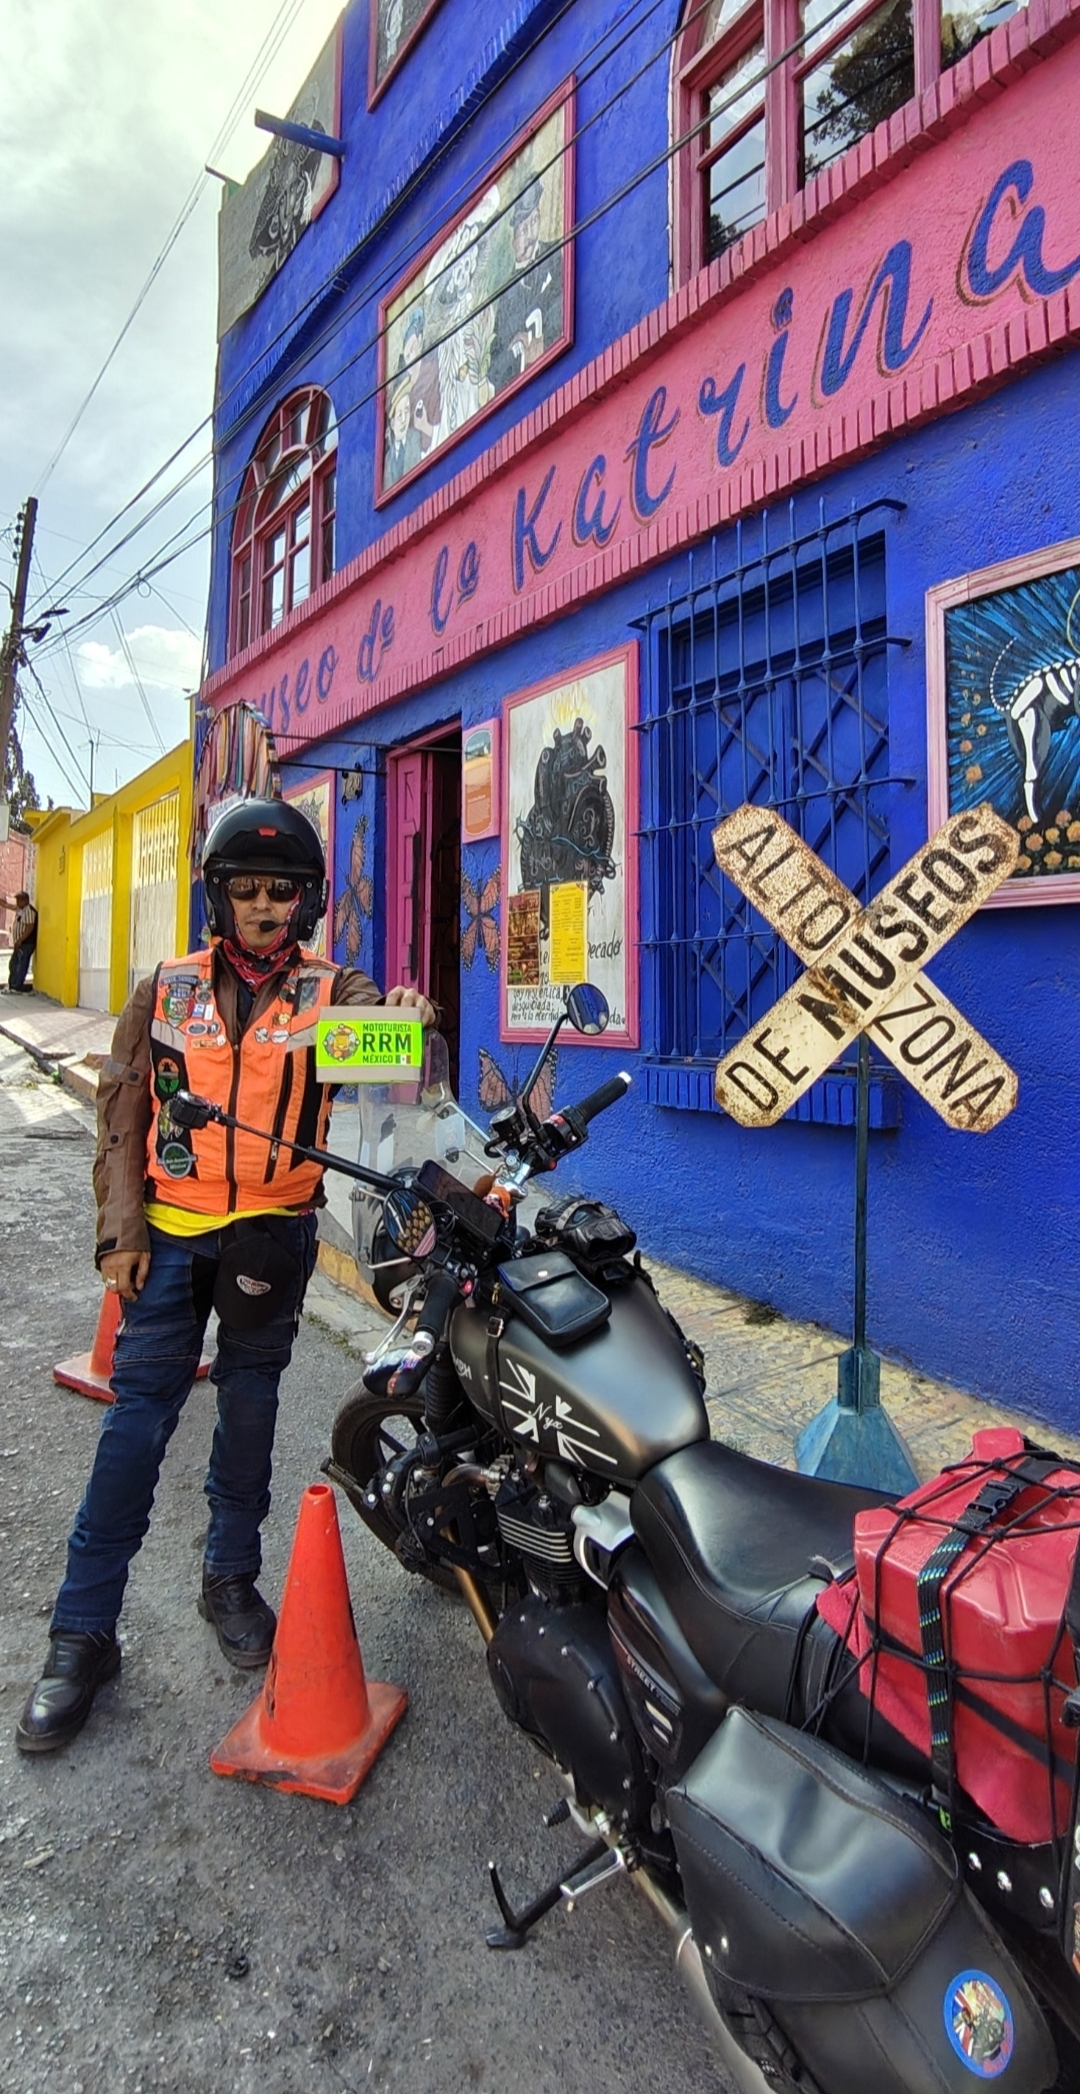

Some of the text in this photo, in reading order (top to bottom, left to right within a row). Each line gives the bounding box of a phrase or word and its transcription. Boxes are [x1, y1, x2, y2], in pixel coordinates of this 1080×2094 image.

[252, 158, 1080, 733] useo de la Katrina
[723, 823, 851, 951] ALTO
[725, 815, 1009, 1113] DE MUSEOS
[363, 1023, 412, 1032] MOTOTURISTA
[363, 1033, 412, 1053] RRM
[363, 1053, 393, 1064] MÉXICO
[872, 982, 1006, 1128] ZONA
[529, 1401, 564, 1430] Nyx
